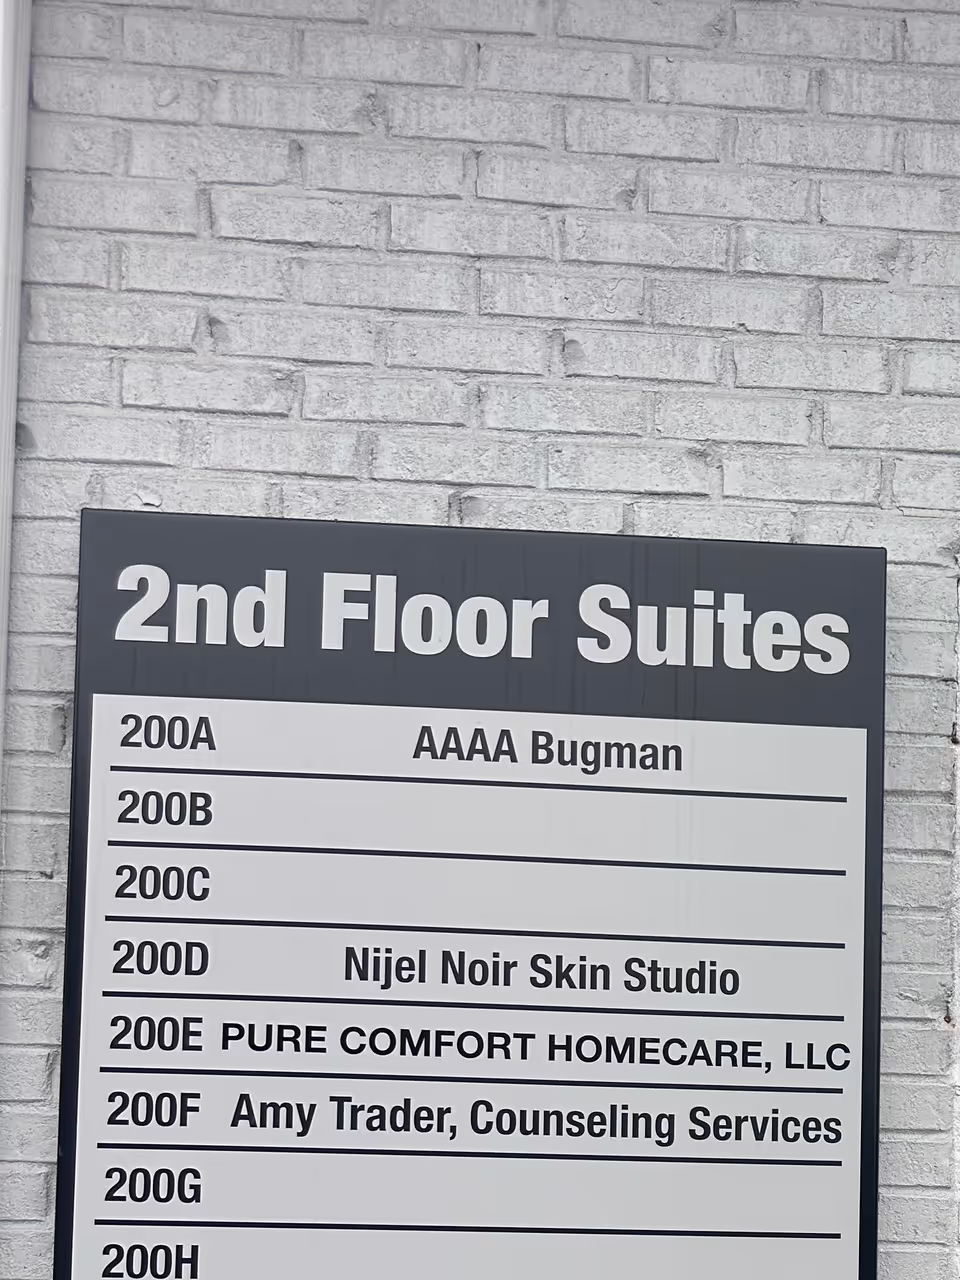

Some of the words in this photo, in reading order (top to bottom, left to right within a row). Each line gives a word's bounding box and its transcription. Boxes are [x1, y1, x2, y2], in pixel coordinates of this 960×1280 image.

[115, 565, 286, 647] 2nd
[322, 573, 548, 658] Floor
[577, 584, 849, 674] Suites
[120, 714, 216, 750] 200A
[413, 726, 518, 763] AAAA
[532, 731, 682, 775] Bugman
[118, 790, 212, 825] 200B
[115, 865, 209, 901] 200C
[113, 940, 208, 975] 200D
[345, 947, 426, 989] Nijel
[442, 951, 517, 986] Noir
[530, 954, 610, 990] Skin
[624, 958, 739, 995] Studio
[110, 1016, 202, 1051] 200E
[222, 1023, 326, 1053] PURE
[340, 1027, 535, 1060] COMFORT
[549, 1034, 771, 1073] HOMECARE,
[786, 1043, 850, 1070] LLC
[107, 1092, 200, 1126] 200F
[231, 1094, 316, 1137] Amy
[329, 1096, 456, 1140] Trader,
[471, 1100, 674, 1147] Counseling
[689, 1107, 841, 1143] Services
[105, 1168, 201, 1203] 200G
[102, 1244, 198, 1279] 200H
